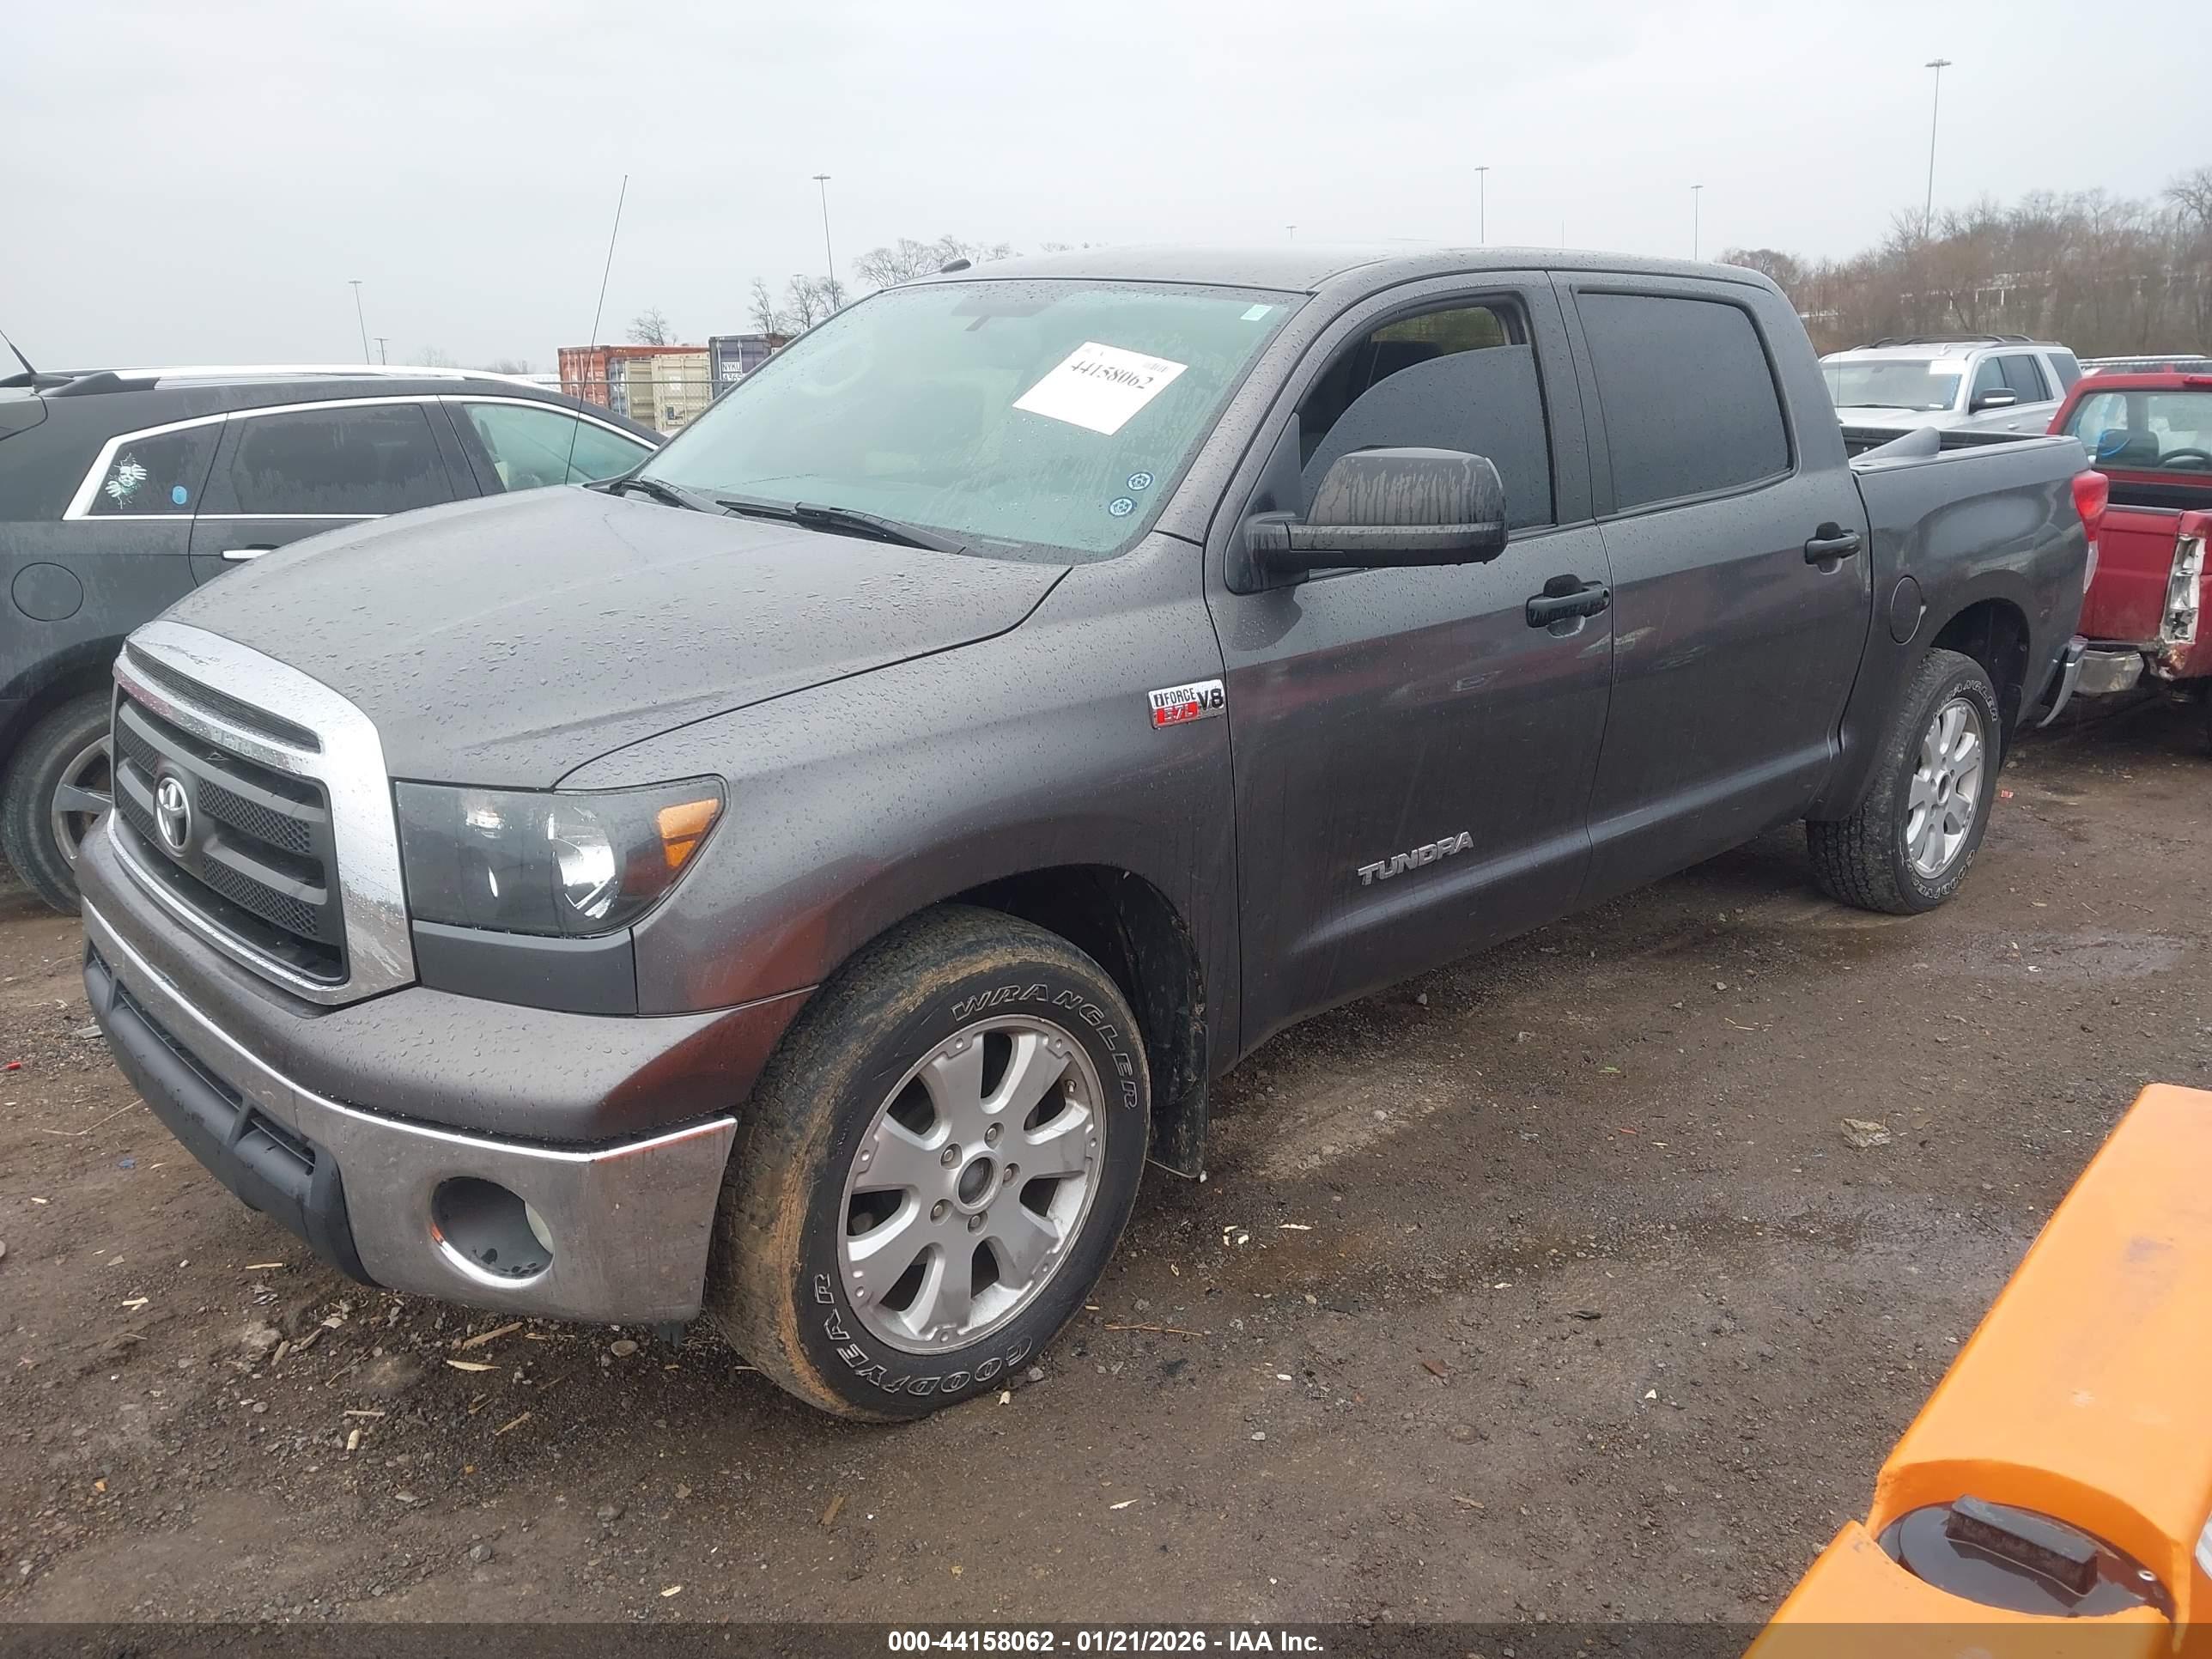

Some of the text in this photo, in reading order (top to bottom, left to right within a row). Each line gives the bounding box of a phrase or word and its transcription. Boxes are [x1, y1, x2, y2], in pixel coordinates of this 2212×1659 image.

[1071, 360, 1154, 389] 44158062
[1197, 689, 1224, 711] V8
[1358, 830, 1474, 886] TUNDRA
[951, 983, 1138, 1109] WRANGLER
[815, 1273, 1032, 1396] GOODYEAR
